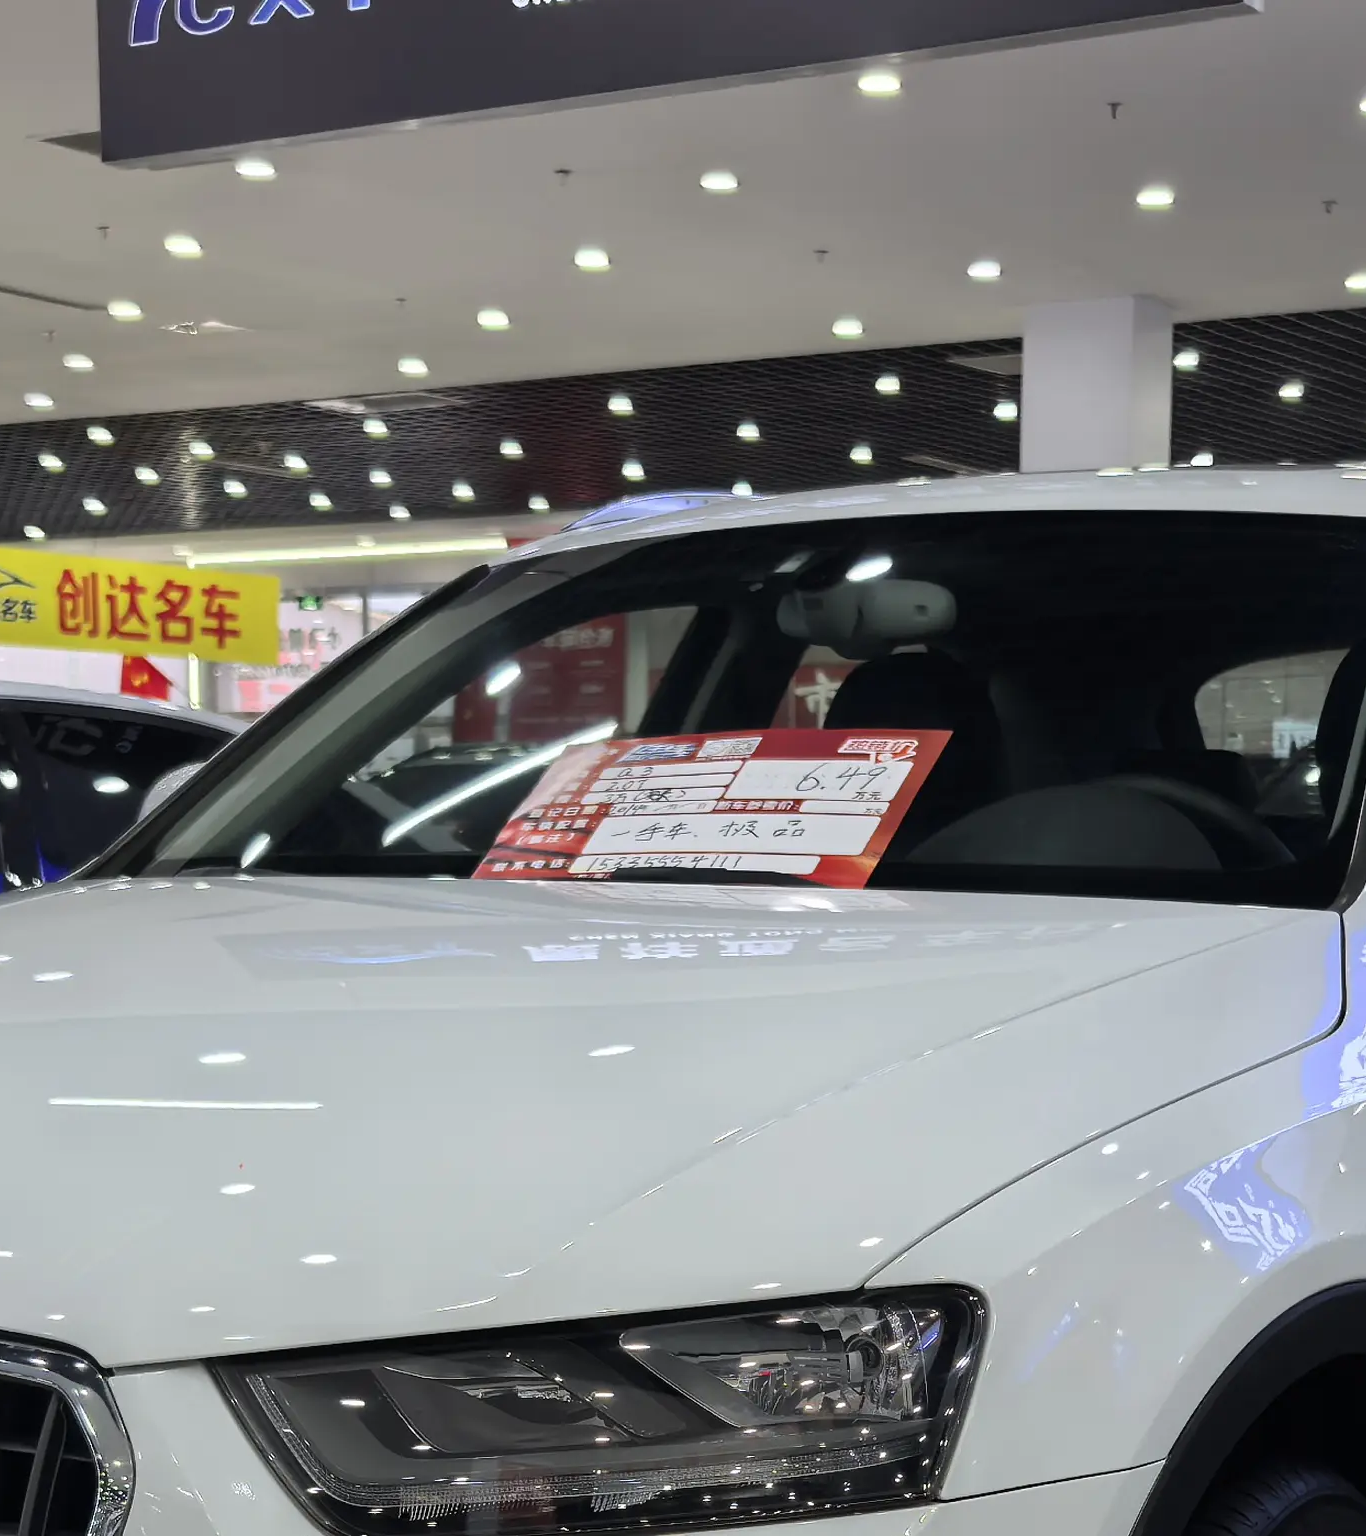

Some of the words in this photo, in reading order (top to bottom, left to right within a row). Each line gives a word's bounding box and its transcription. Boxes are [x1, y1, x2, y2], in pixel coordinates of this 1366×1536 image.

[56, 568, 241, 649] 创达名车
[795, 762, 889, 792] 6.49
